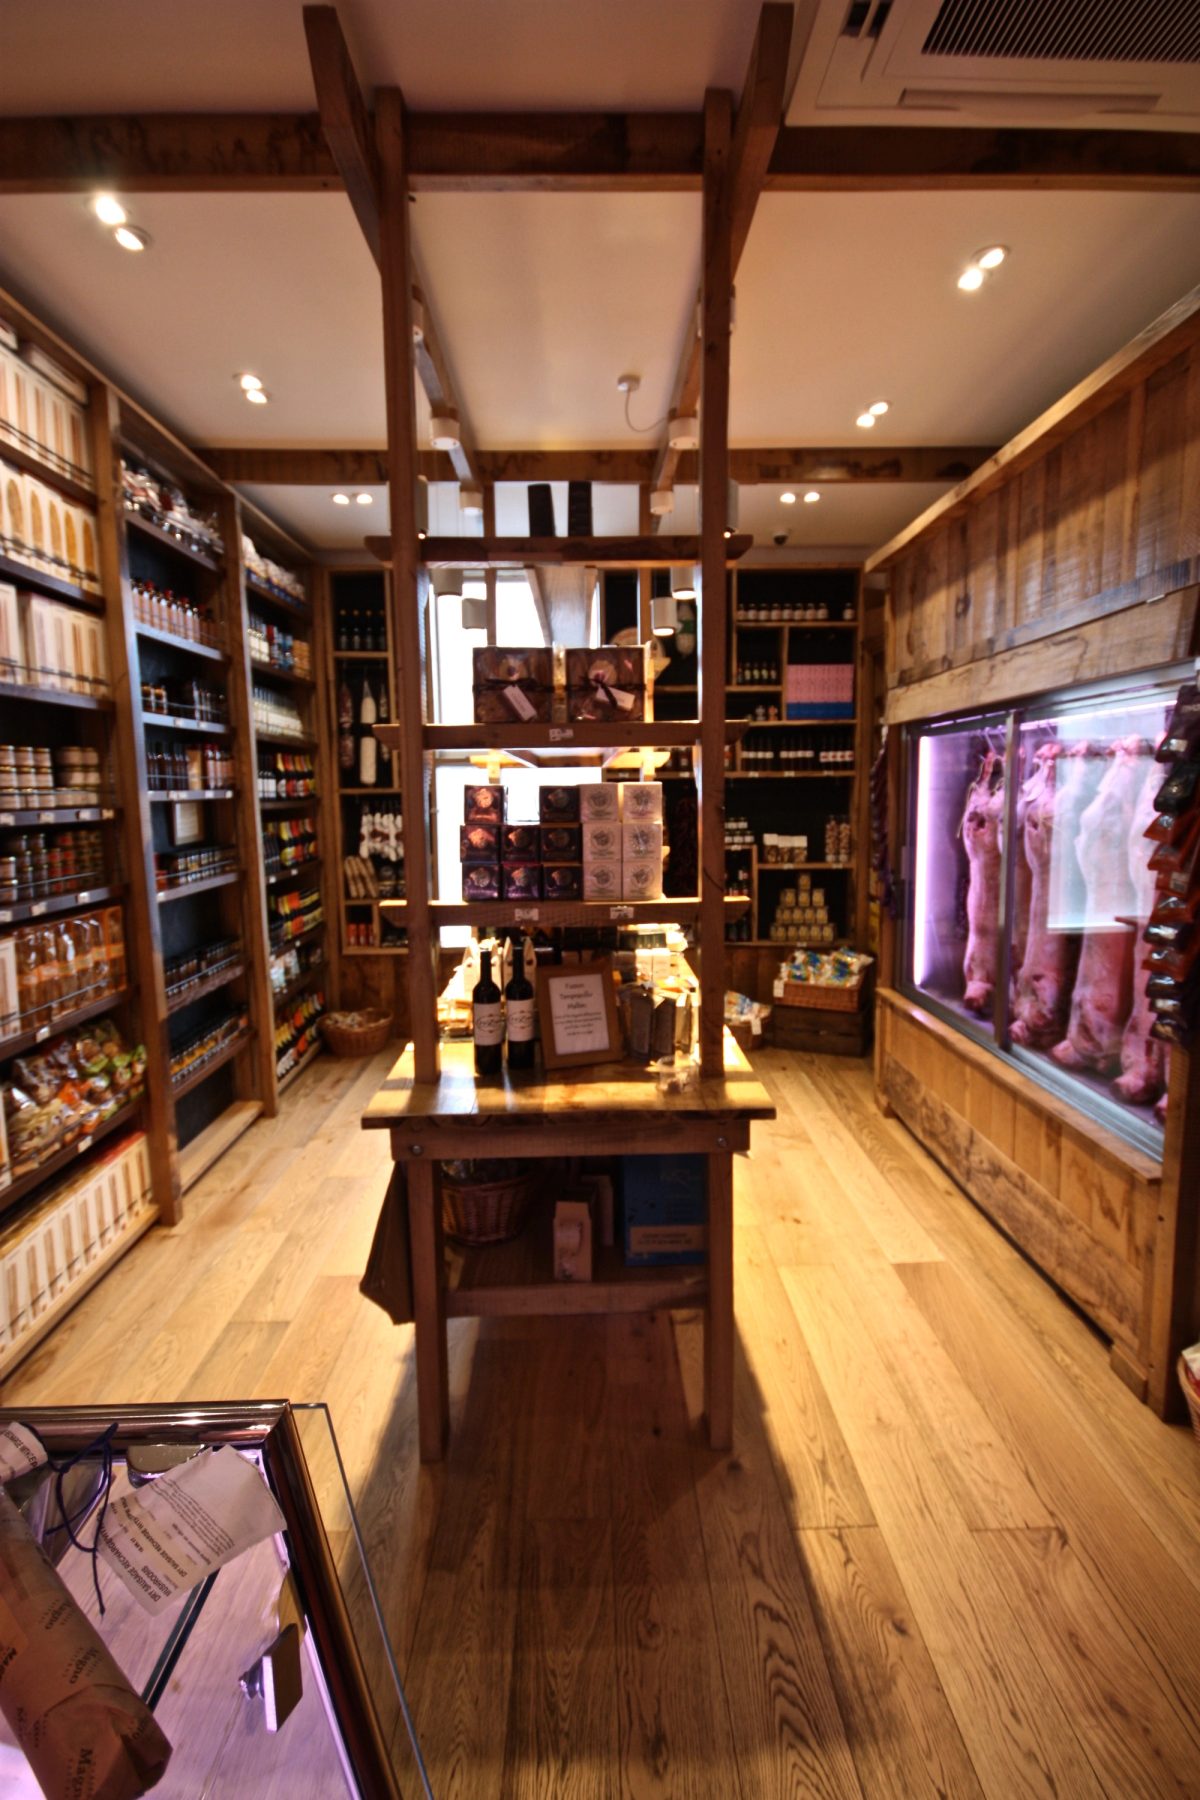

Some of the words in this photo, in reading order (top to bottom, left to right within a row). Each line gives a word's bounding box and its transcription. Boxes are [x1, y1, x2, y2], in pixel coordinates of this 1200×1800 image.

[141, 1528, 162, 1551] RECHARGE
[104, 1537, 130, 1569] RECHARGE
[159, 1550, 178, 1569] SAUSAGE
[127, 1567, 150, 1592] SAUSAGE
[140, 1565, 171, 1597] MUSHROOMS
[175, 1566, 187, 1577] DRY
[147, 1589, 160, 1602] DRY
